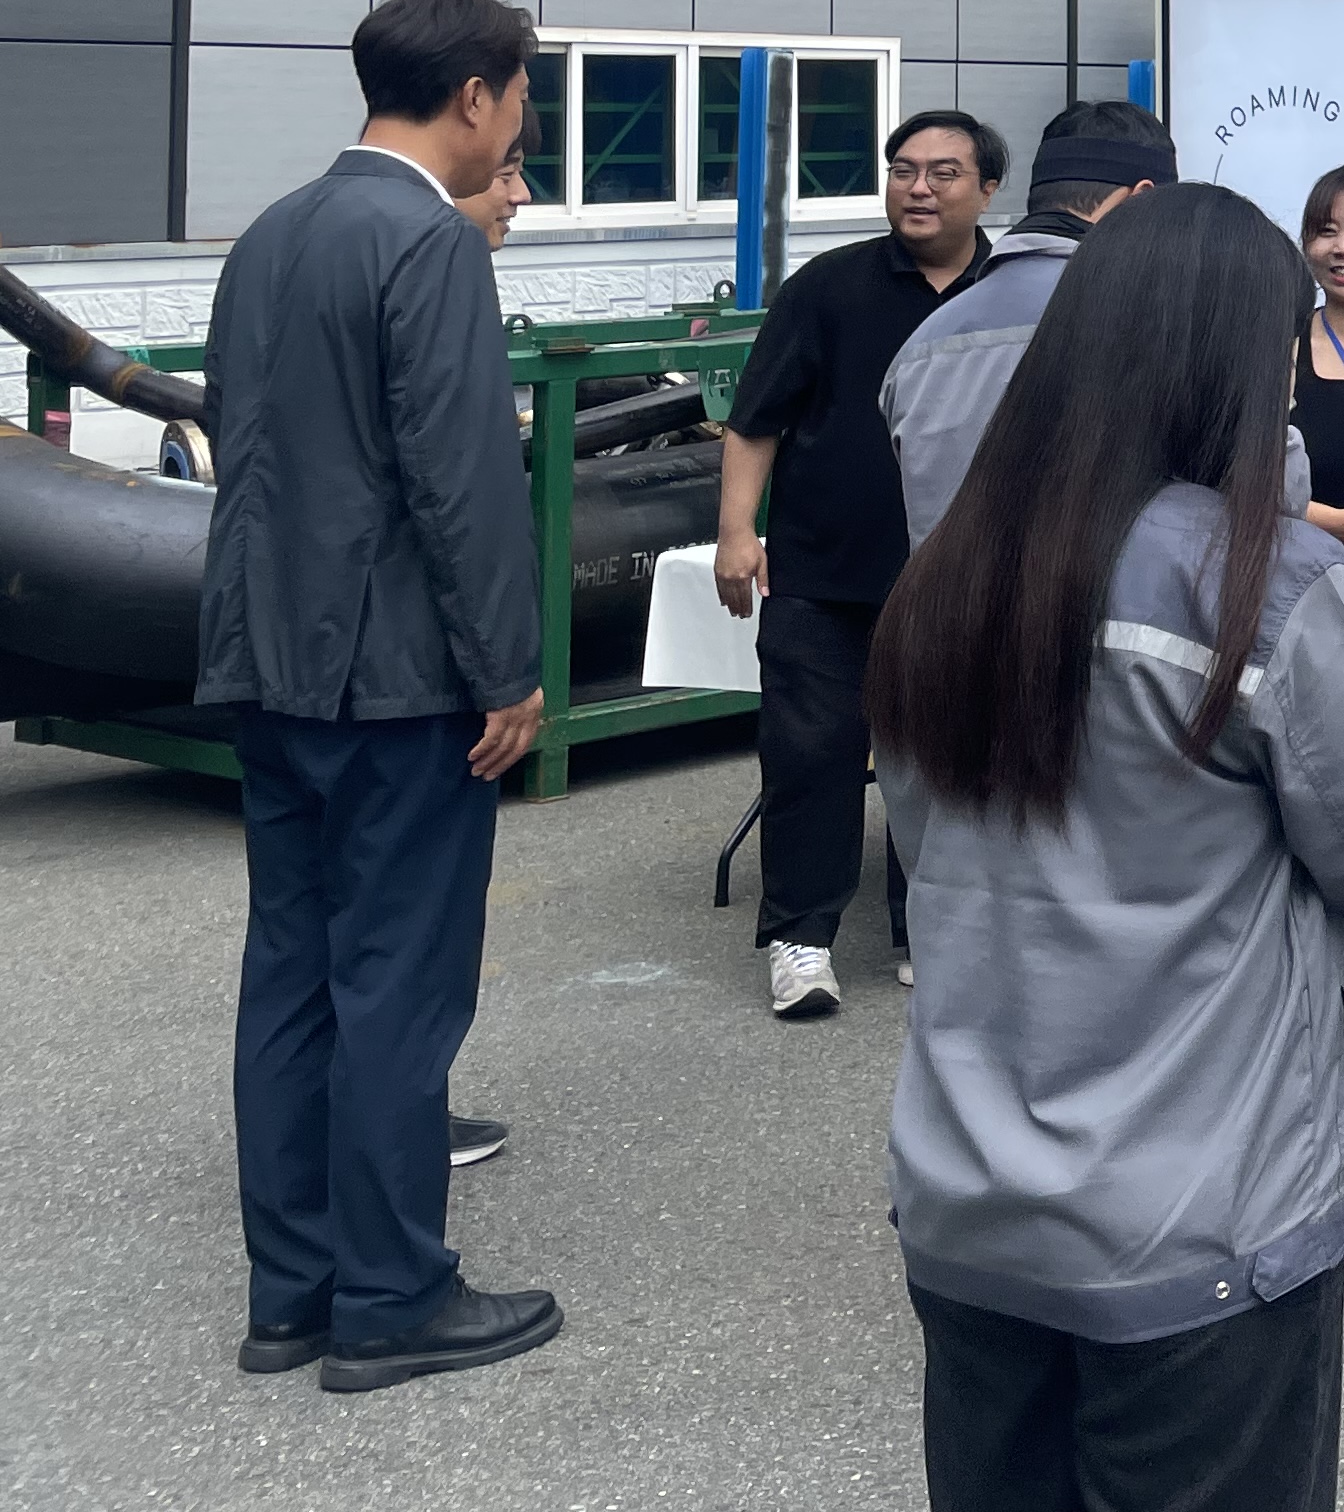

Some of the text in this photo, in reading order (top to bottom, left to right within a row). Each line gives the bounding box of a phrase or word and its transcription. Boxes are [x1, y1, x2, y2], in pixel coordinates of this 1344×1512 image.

[1214, 86, 1340, 146] ROAMING
[573, 550, 654, 590] MADE IN
